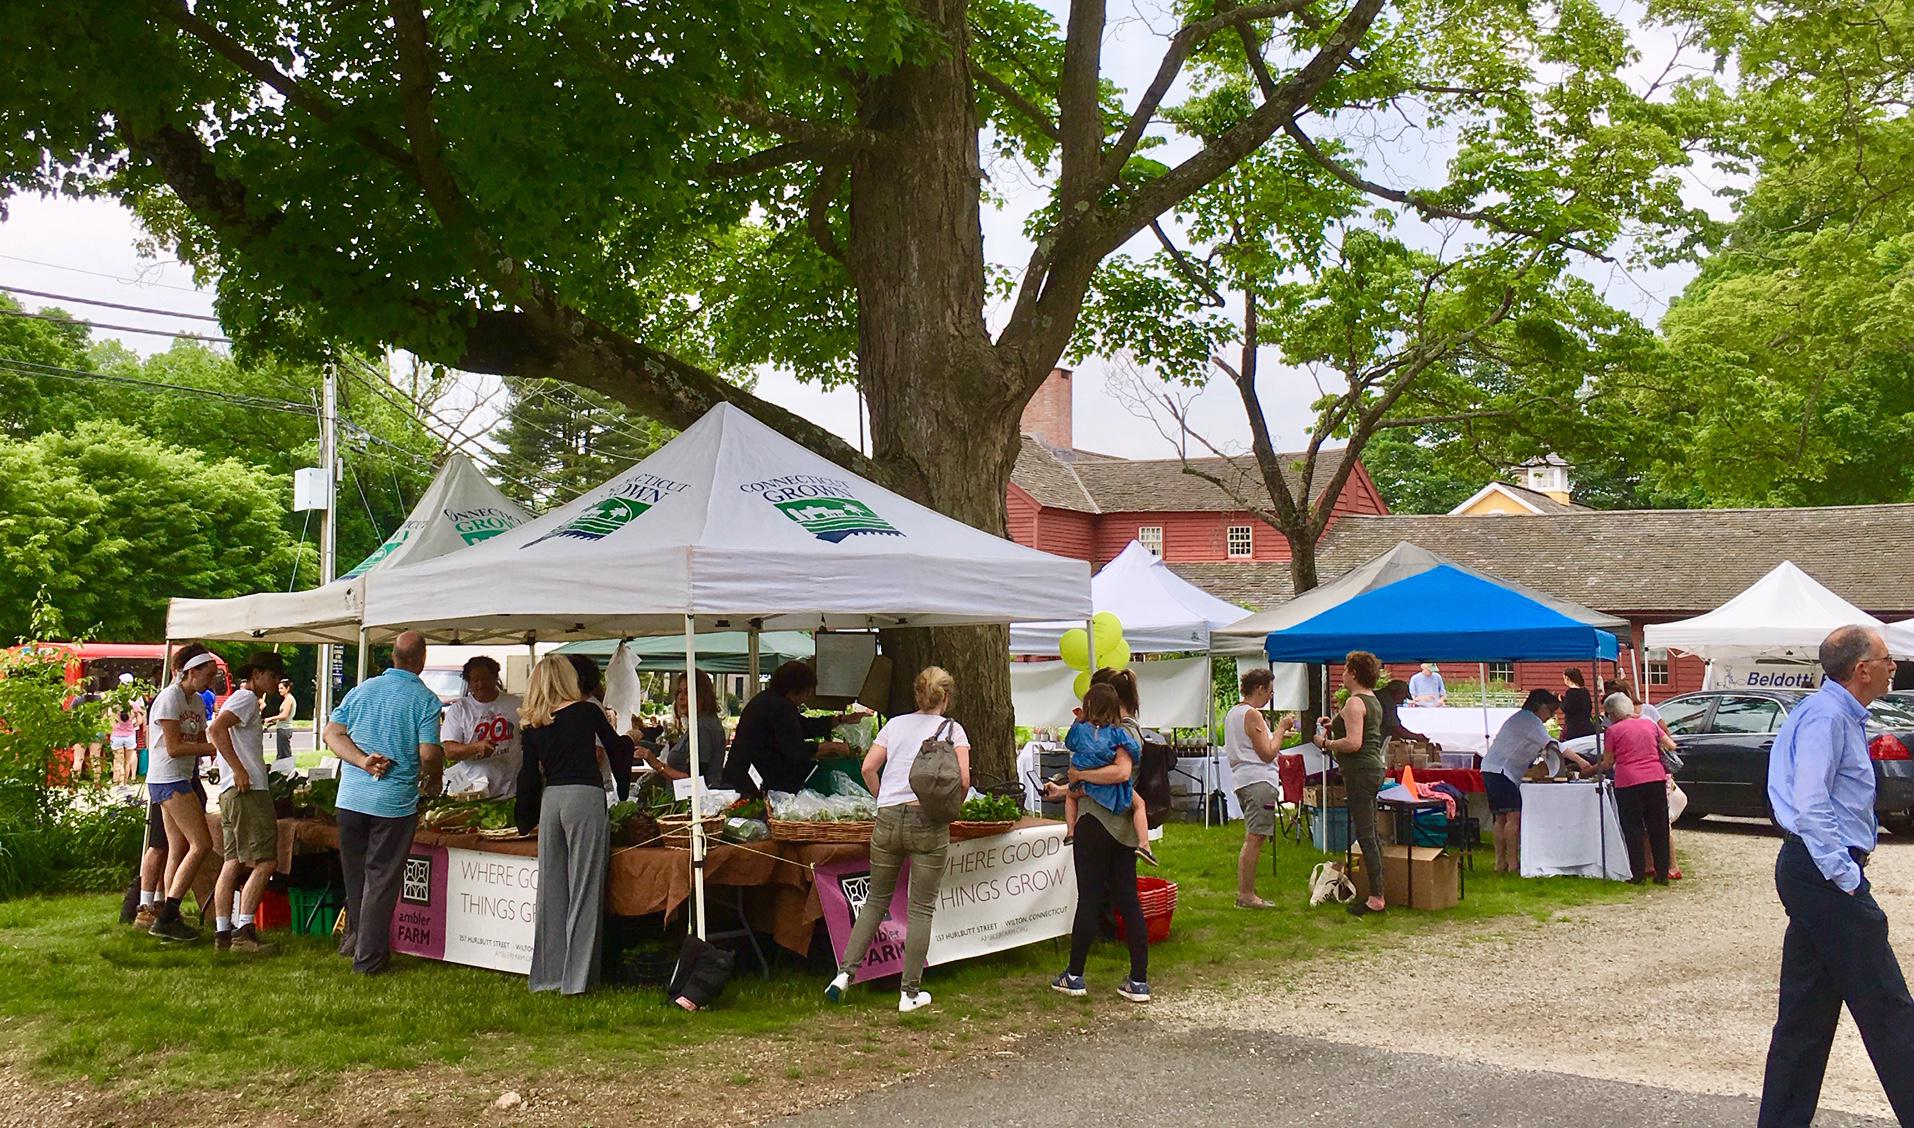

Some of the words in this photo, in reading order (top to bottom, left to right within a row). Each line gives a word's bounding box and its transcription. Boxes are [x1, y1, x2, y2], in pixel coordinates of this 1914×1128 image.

[740, 474, 851, 493] CONNECTICUT
[762, 485, 855, 503] GROWN
[455, 518, 512, 533] GROW
[1747, 671, 1814, 687] Beldotti
[1001, 836, 1060, 865] GOOD
[461, 860, 514, 887] WHERE
[518, 867, 539, 890] GO
[941, 879, 1001, 910] HINGS
[1005, 865, 1067, 896] GROW
[461, 893, 516, 921] THINGS
[399, 911, 431, 927] ambler
[976, 923, 998, 934] STREET
[1028, 905, 1068, 922] CONNECTICUT
[398, 925, 431, 945] FARM
[493, 940, 510, 949] STREET
[874, 927, 900, 944] bler
[866, 942, 906, 967] ARM
